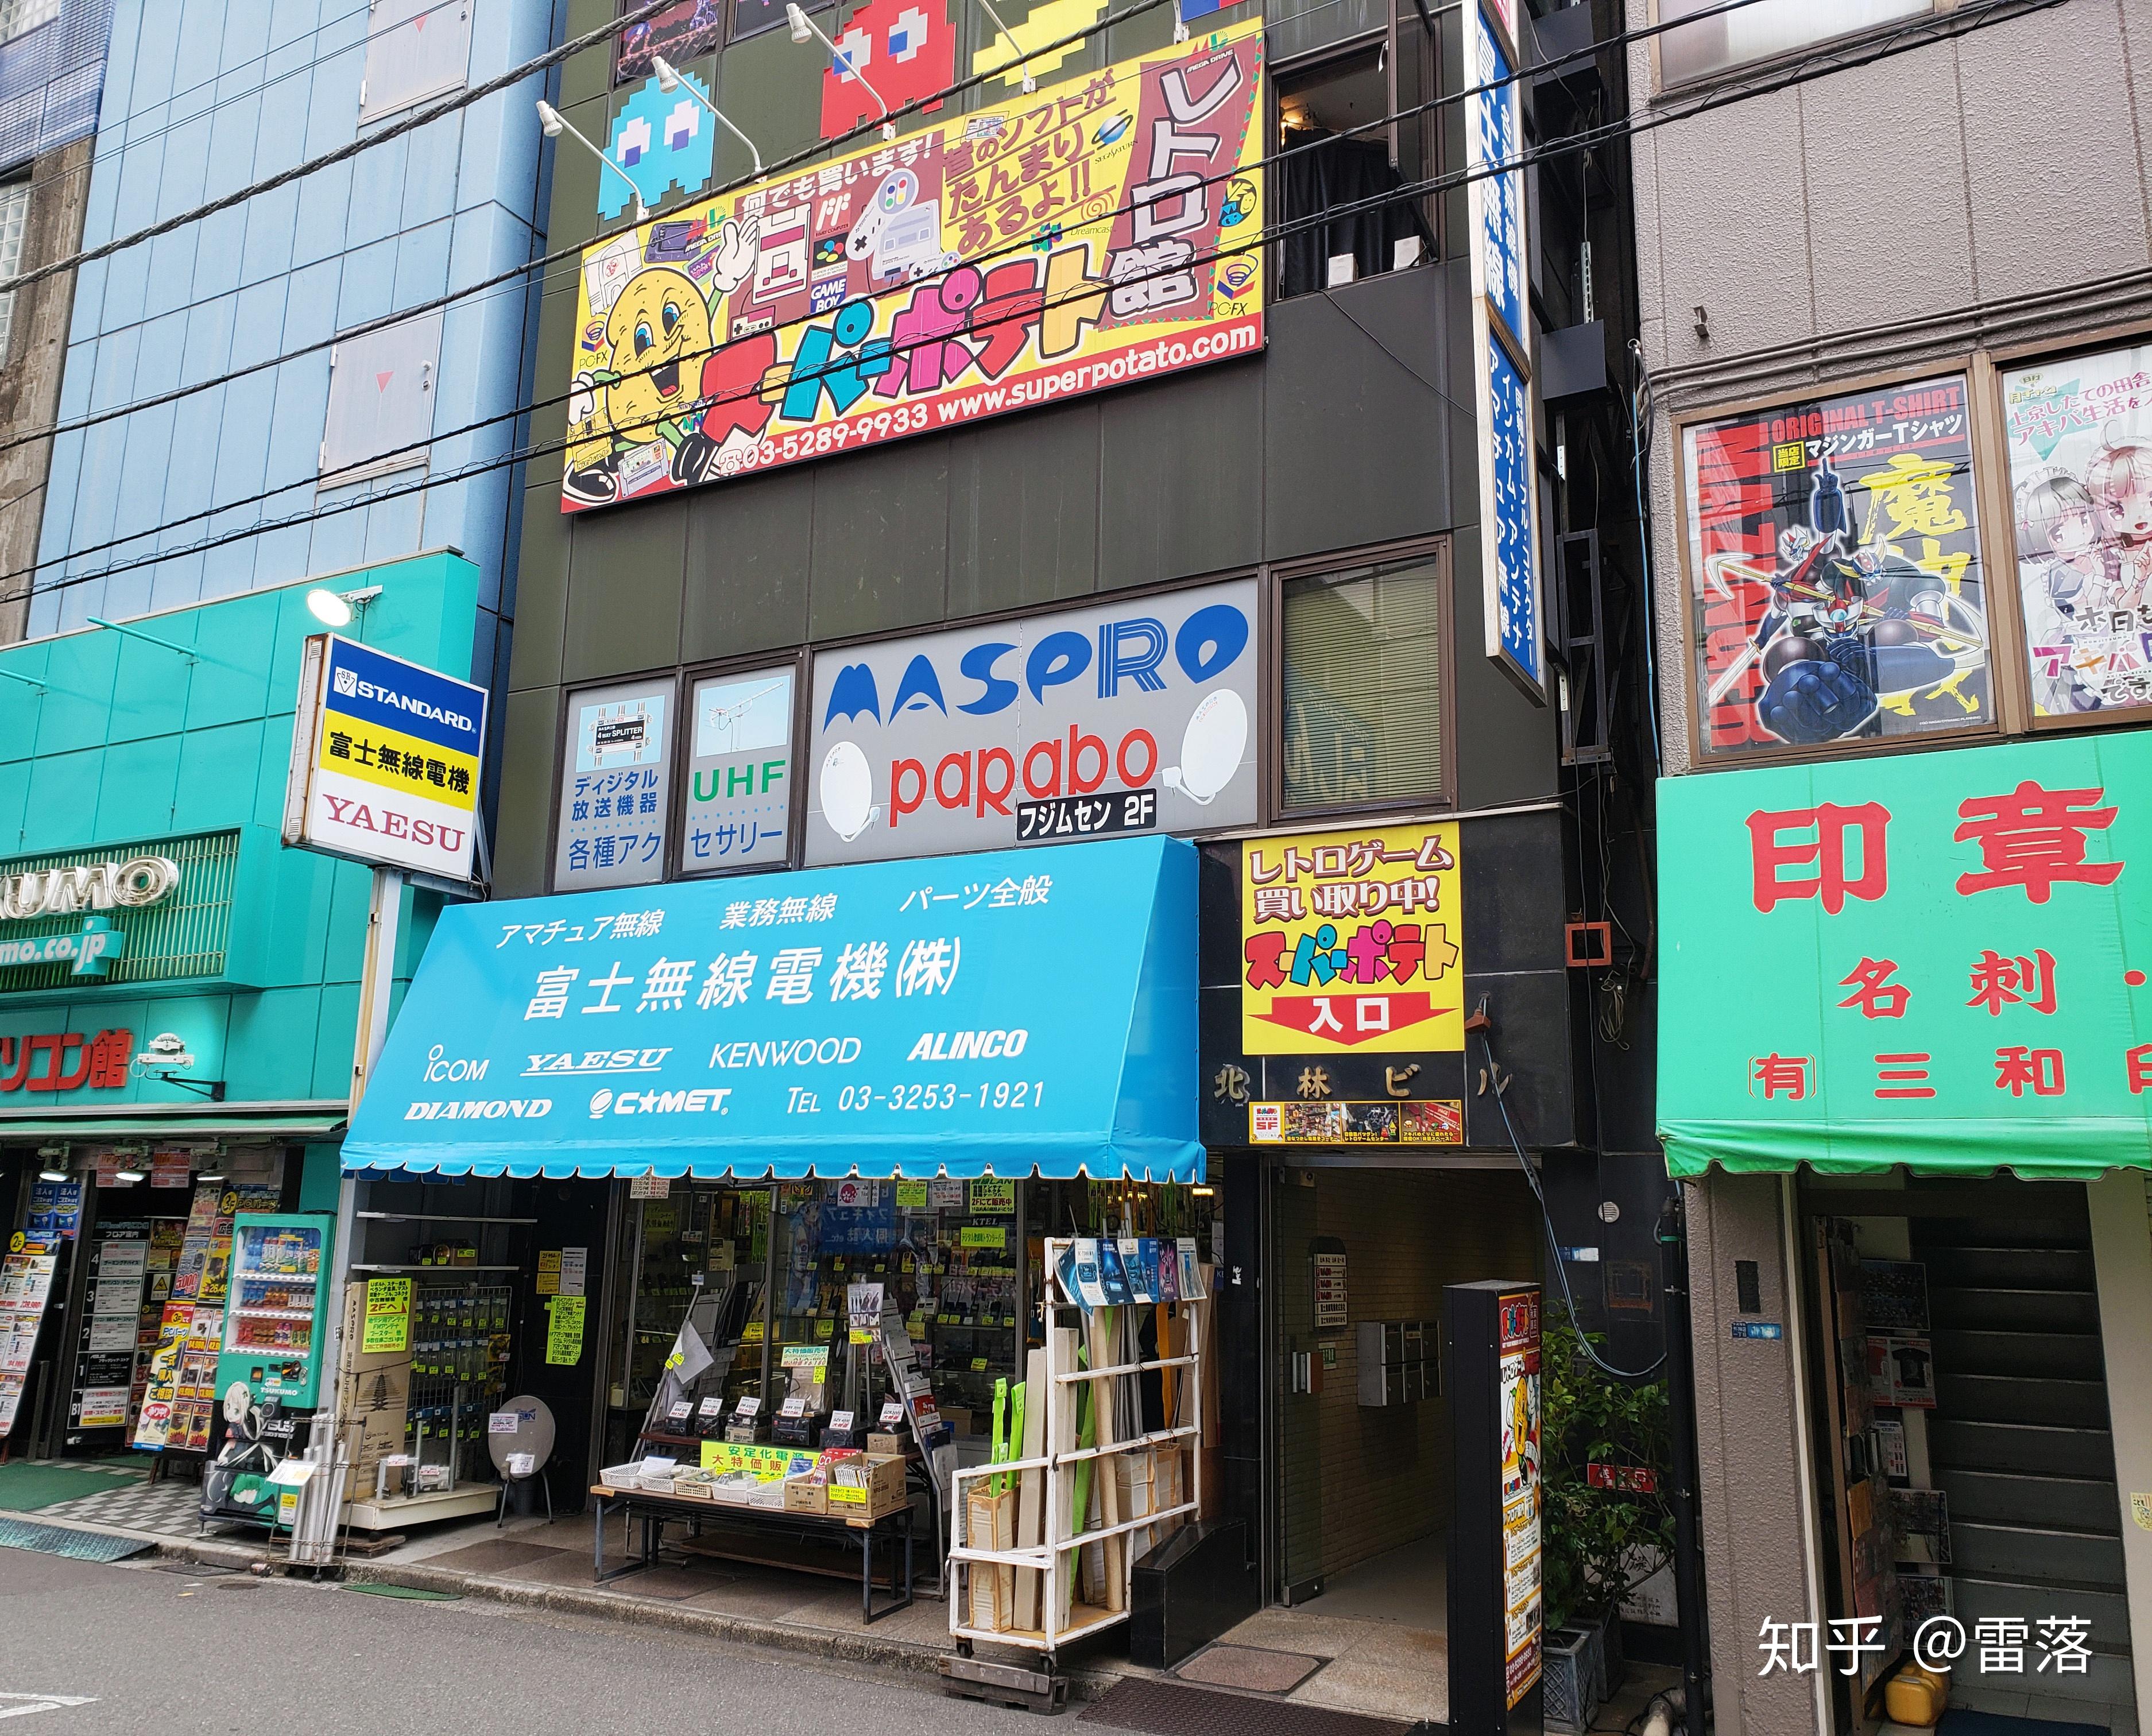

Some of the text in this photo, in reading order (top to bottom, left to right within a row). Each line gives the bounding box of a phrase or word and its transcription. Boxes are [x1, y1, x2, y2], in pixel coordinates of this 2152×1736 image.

[1186, 49, 1234, 74] MEGA DRIVE
[943, 68, 1116, 180] 昔のソフトが
[949, 123, 1085, 219] たんまり
[1109, 51, 1242, 318] レトロ館
[958, 163, 1091, 253] あるよ!!
[829, 223, 849, 232] COMPUTER
[1070, 224, 1113, 236] Dreamcast
[811, 278, 846, 300] GAME
[816, 294, 841, 312] BOY
[703, 244, 1115, 443] スーパーポテト
[742, 324, 1256, 468] 03-5289-9933 www.superpotato.com
[1772, 386, 1961, 443] ORIGINAL T-SHIRT
[1776, 445, 1798, 459] 当店
[1805, 413, 1963, 458] マジンガーTシャツ
[1777, 456, 1799, 468] 限定
[823, 604, 1249, 735] MASPRO
[611, 726, 642, 737] SPLITTER
[330, 731, 470, 795] 富士無線電機
[575, 769, 659, 798] ディジタル
[694, 760, 786, 802] UHF
[323, 794, 466, 852] YAESU
[572, 792, 657, 822] 放送機器
[1020, 795, 1154, 839] フジムセン 2F
[568, 832, 661, 871] 各種アク
[691, 822, 783, 858] セサリー
[1745, 779, 2126, 916] 印章
[1250, 835, 1454, 884] レトロゲーム
[0, 855, 179, 919] UMO
[1254, 876, 1439, 924] 買い取り中!
[496, 874, 1053, 948] アマチュア無線 業務無線 パーツ全般
[1245, 919, 1460, 990] スーパーポテト
[1308, 997, 1390, 1033] 入口
[520, 1029, 1028, 1076] YAESU KENWOOD ALINCO
[404, 1099, 552, 1121] DIAMOND
[838, 1081, 1044, 1110] 03-3253-1921
[223, 1194, 235, 1210] 3F
[972, 1198, 1012, 1206] 2Fにて販売中
[962, 1233, 1004, 1242] デジタルトランシーバー
[972, 1218, 998, 1226] KTEL
[12, 1235, 22, 1249] 2F
[91, 1253, 99, 1264] 4
[87, 1291, 95, 1302] 3
[370, 1303, 397, 1312] 2Fへ
[82, 1328, 90, 1339] 2
[162, 1327, 188, 1338] PCパーツ
[79, 1365, 84, 1376] 1
[260, 1387, 298, 1396] TSUKUMO
[71, 1403, 80, 1415] B1
[728, 1446, 804, 1461] 安定化電源
